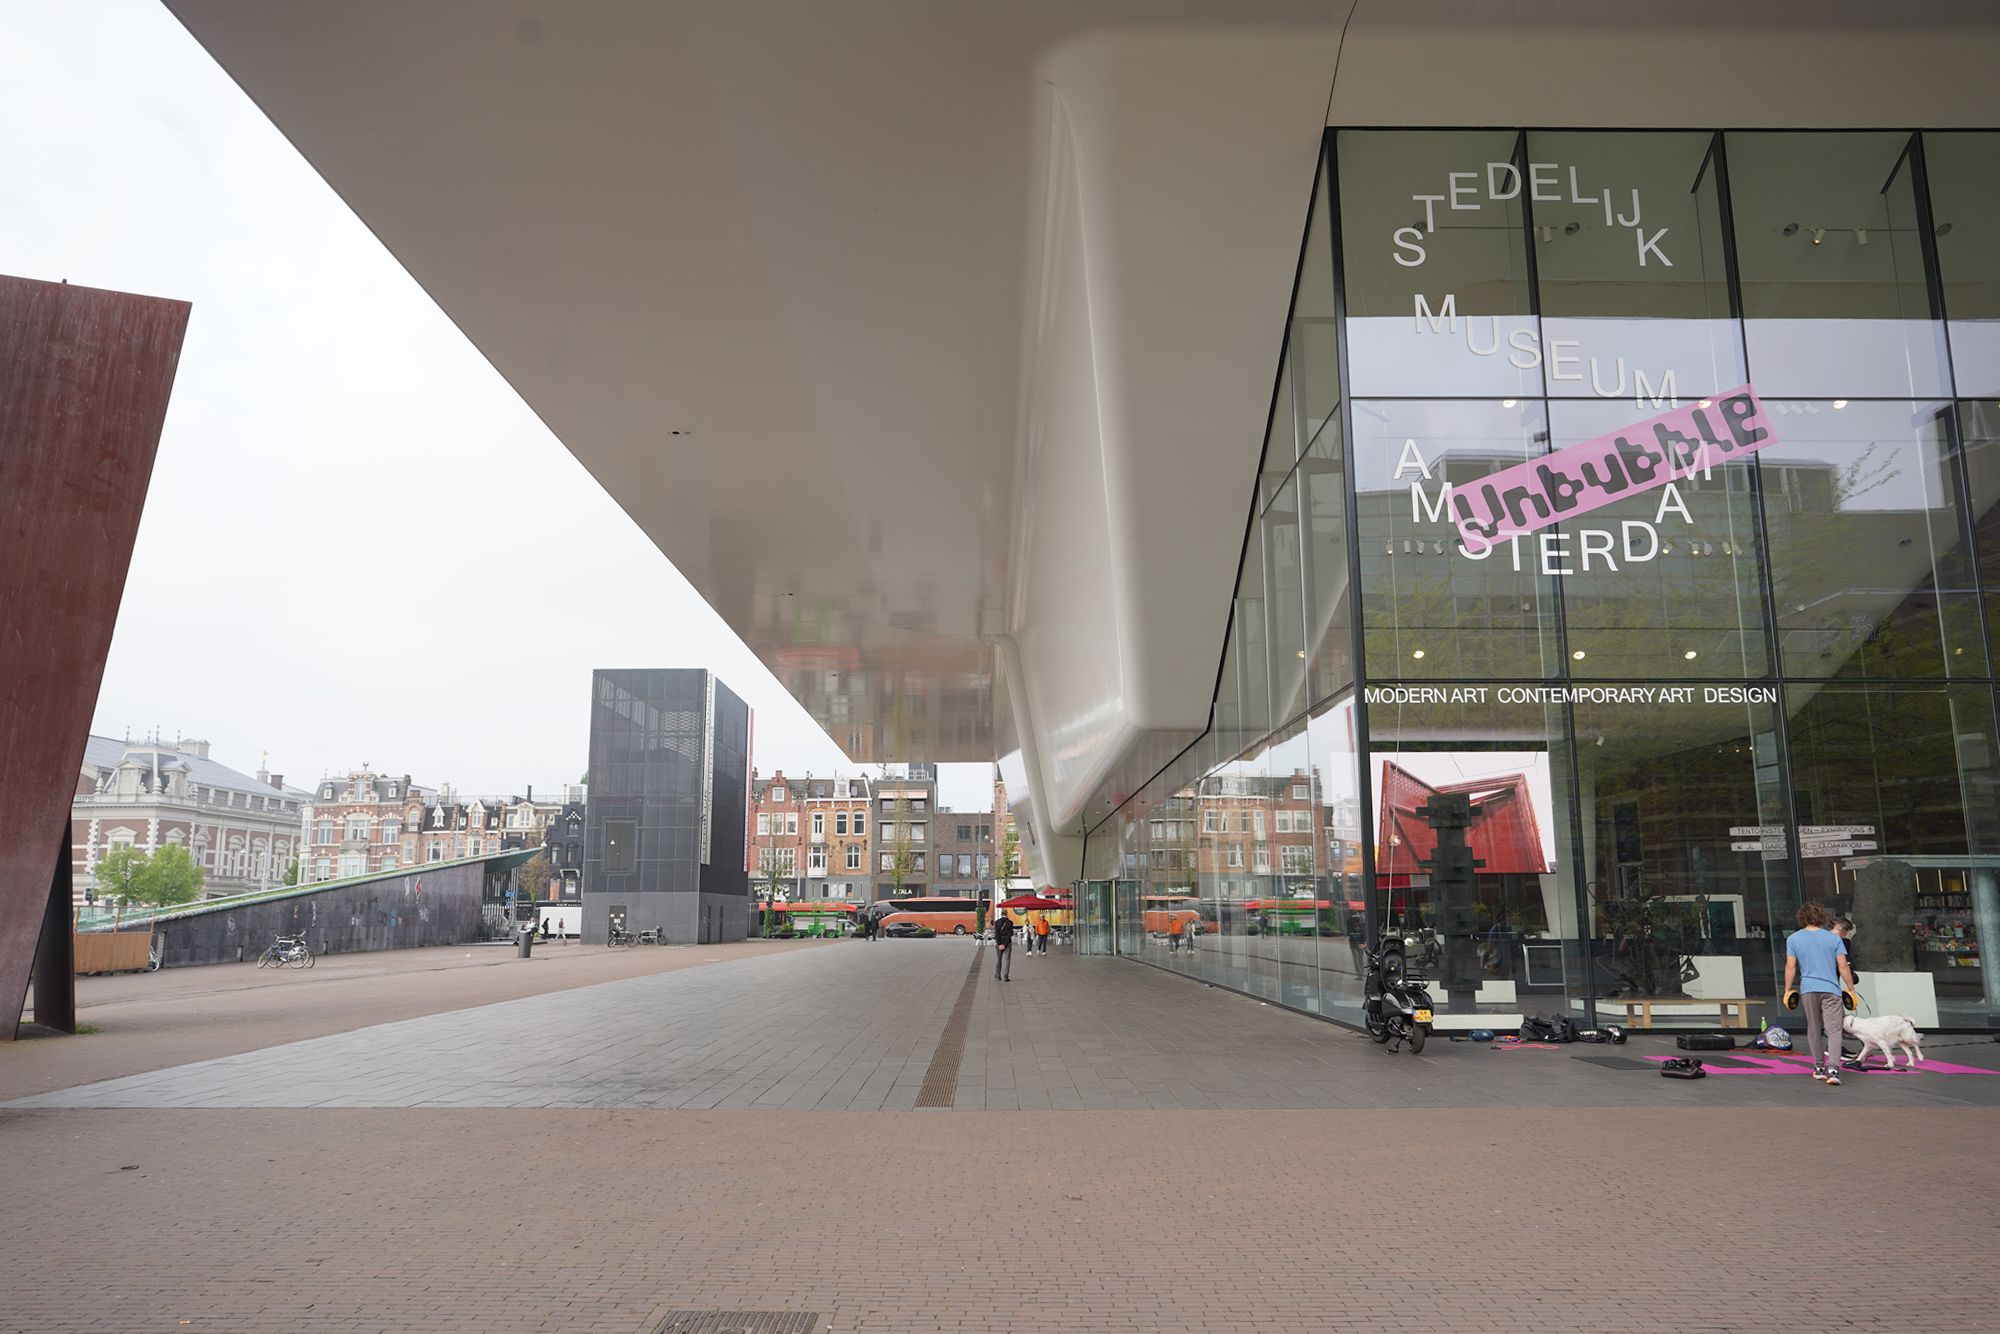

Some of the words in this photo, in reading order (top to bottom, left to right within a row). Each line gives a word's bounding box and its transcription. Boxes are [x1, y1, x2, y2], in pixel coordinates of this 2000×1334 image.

[1393, 162, 1673, 267] STEDELIJK
[1414, 294, 1678, 409] MUSEUM
[1393, 439, 1712, 575] AMSTERDAM
[1454, 392, 1769, 538] Unbubble
[1364, 687, 1447, 704] MODERN
[1450, 687, 1488, 704] ART
[1498, 687, 1656, 704] CONTEMPORARY
[1658, 687, 1695, 704] ART
[1704, 687, 1777, 704] DESIGN
